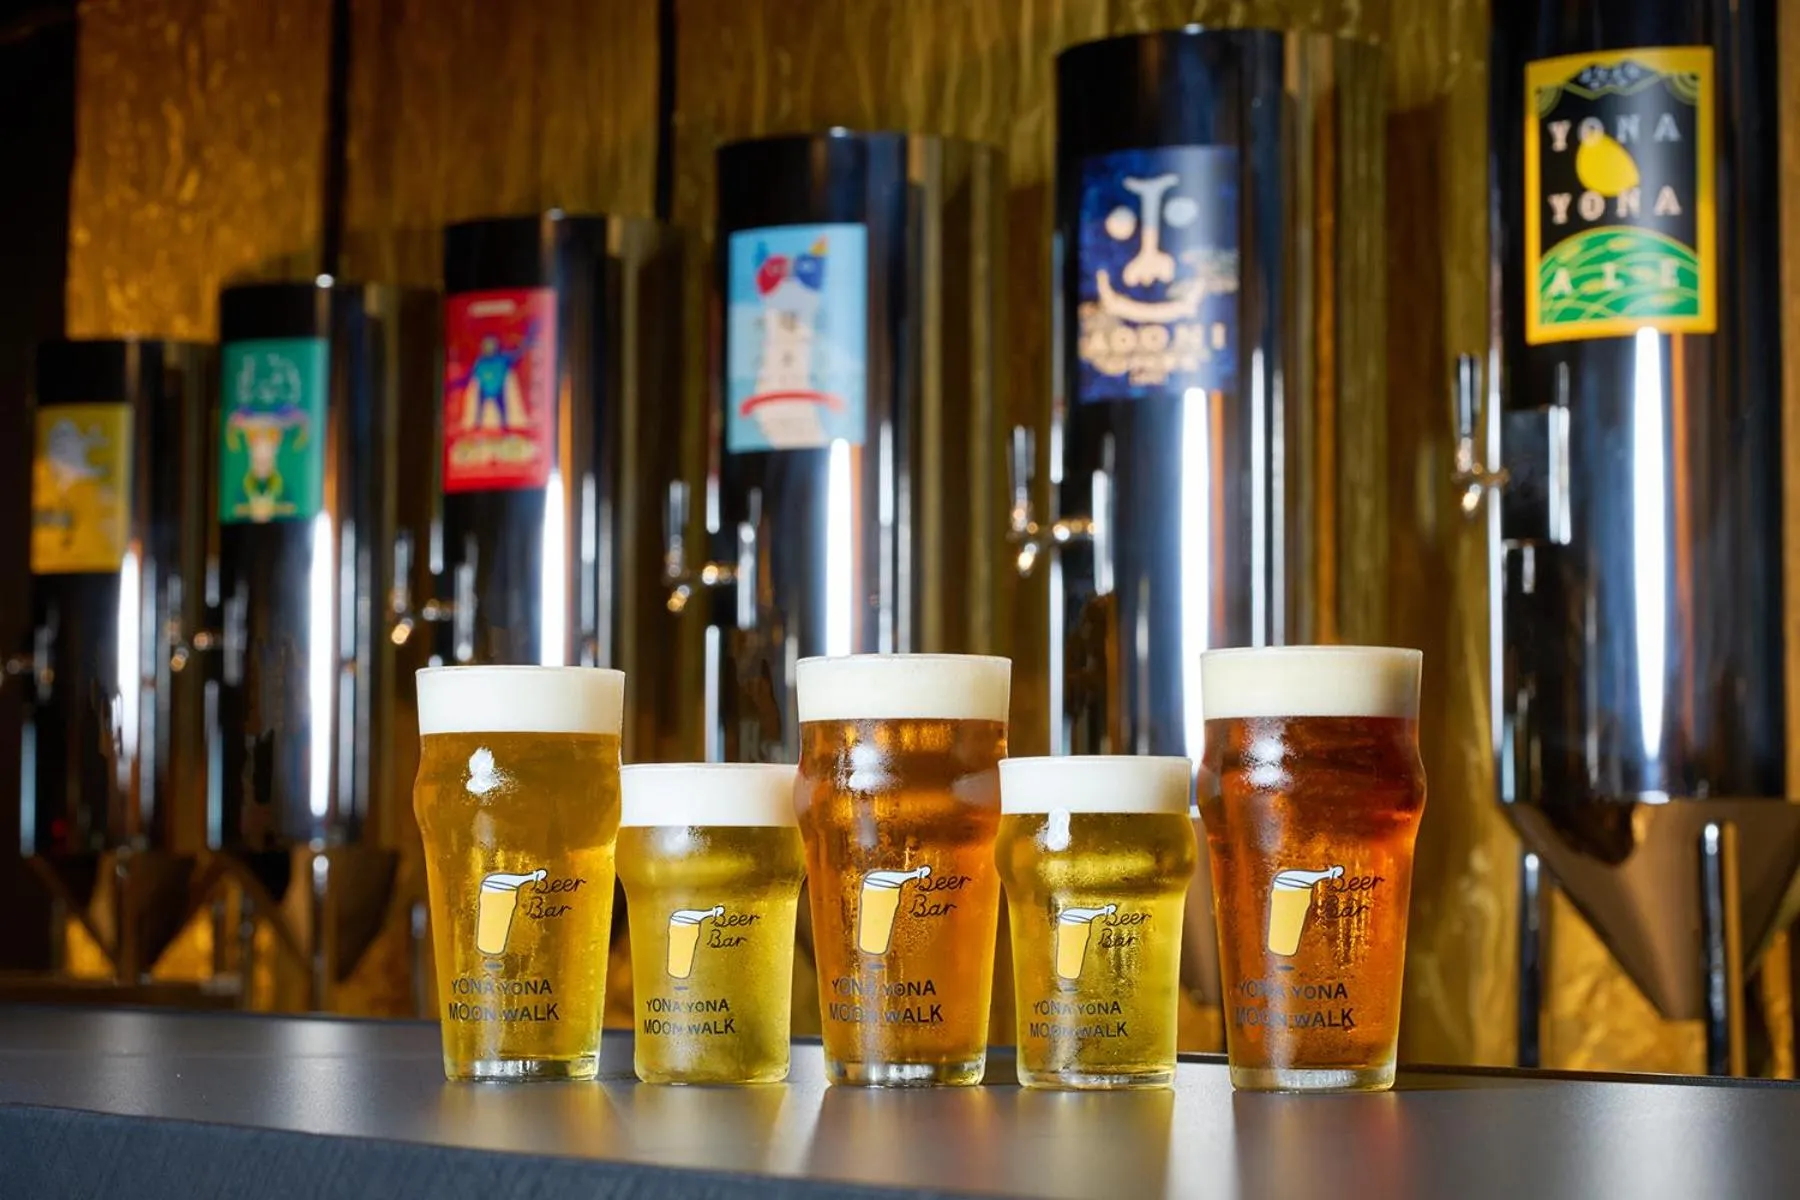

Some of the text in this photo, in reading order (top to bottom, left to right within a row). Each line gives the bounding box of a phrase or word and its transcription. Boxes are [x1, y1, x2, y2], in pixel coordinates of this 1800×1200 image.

[1548, 112, 1683, 153] YONA
[1548, 184, 1683, 225] YONA
[531, 872, 586, 893] Beer
[915, 870, 972, 892] Beer
[1328, 870, 1385, 892] Beer
[527, 896, 573, 919] Bar
[910, 894, 957, 917] Bar
[1324, 895, 1370, 919] Bar
[712, 908, 760, 927] Beer
[1104, 907, 1152, 926] Beer
[707, 929, 747, 948] Bar
[1099, 928, 1139, 948] Bar
[451, 978, 552, 995] YONA YONA
[832, 977, 936, 996] YONA YONA
[1238, 979, 1349, 1000] YONA YONA
[449, 1003, 559, 1021] MOON WALK
[646, 998, 729, 1013] YONA YONA
[829, 1003, 943, 1023] MOON WALK
[1033, 1000, 1122, 1015] YONA YONA
[644, 1018, 736, 1035] MOON WALK
[1235, 1006, 1356, 1028] MOON WALK
[1029, 1021, 1128, 1038] MOON WALK
